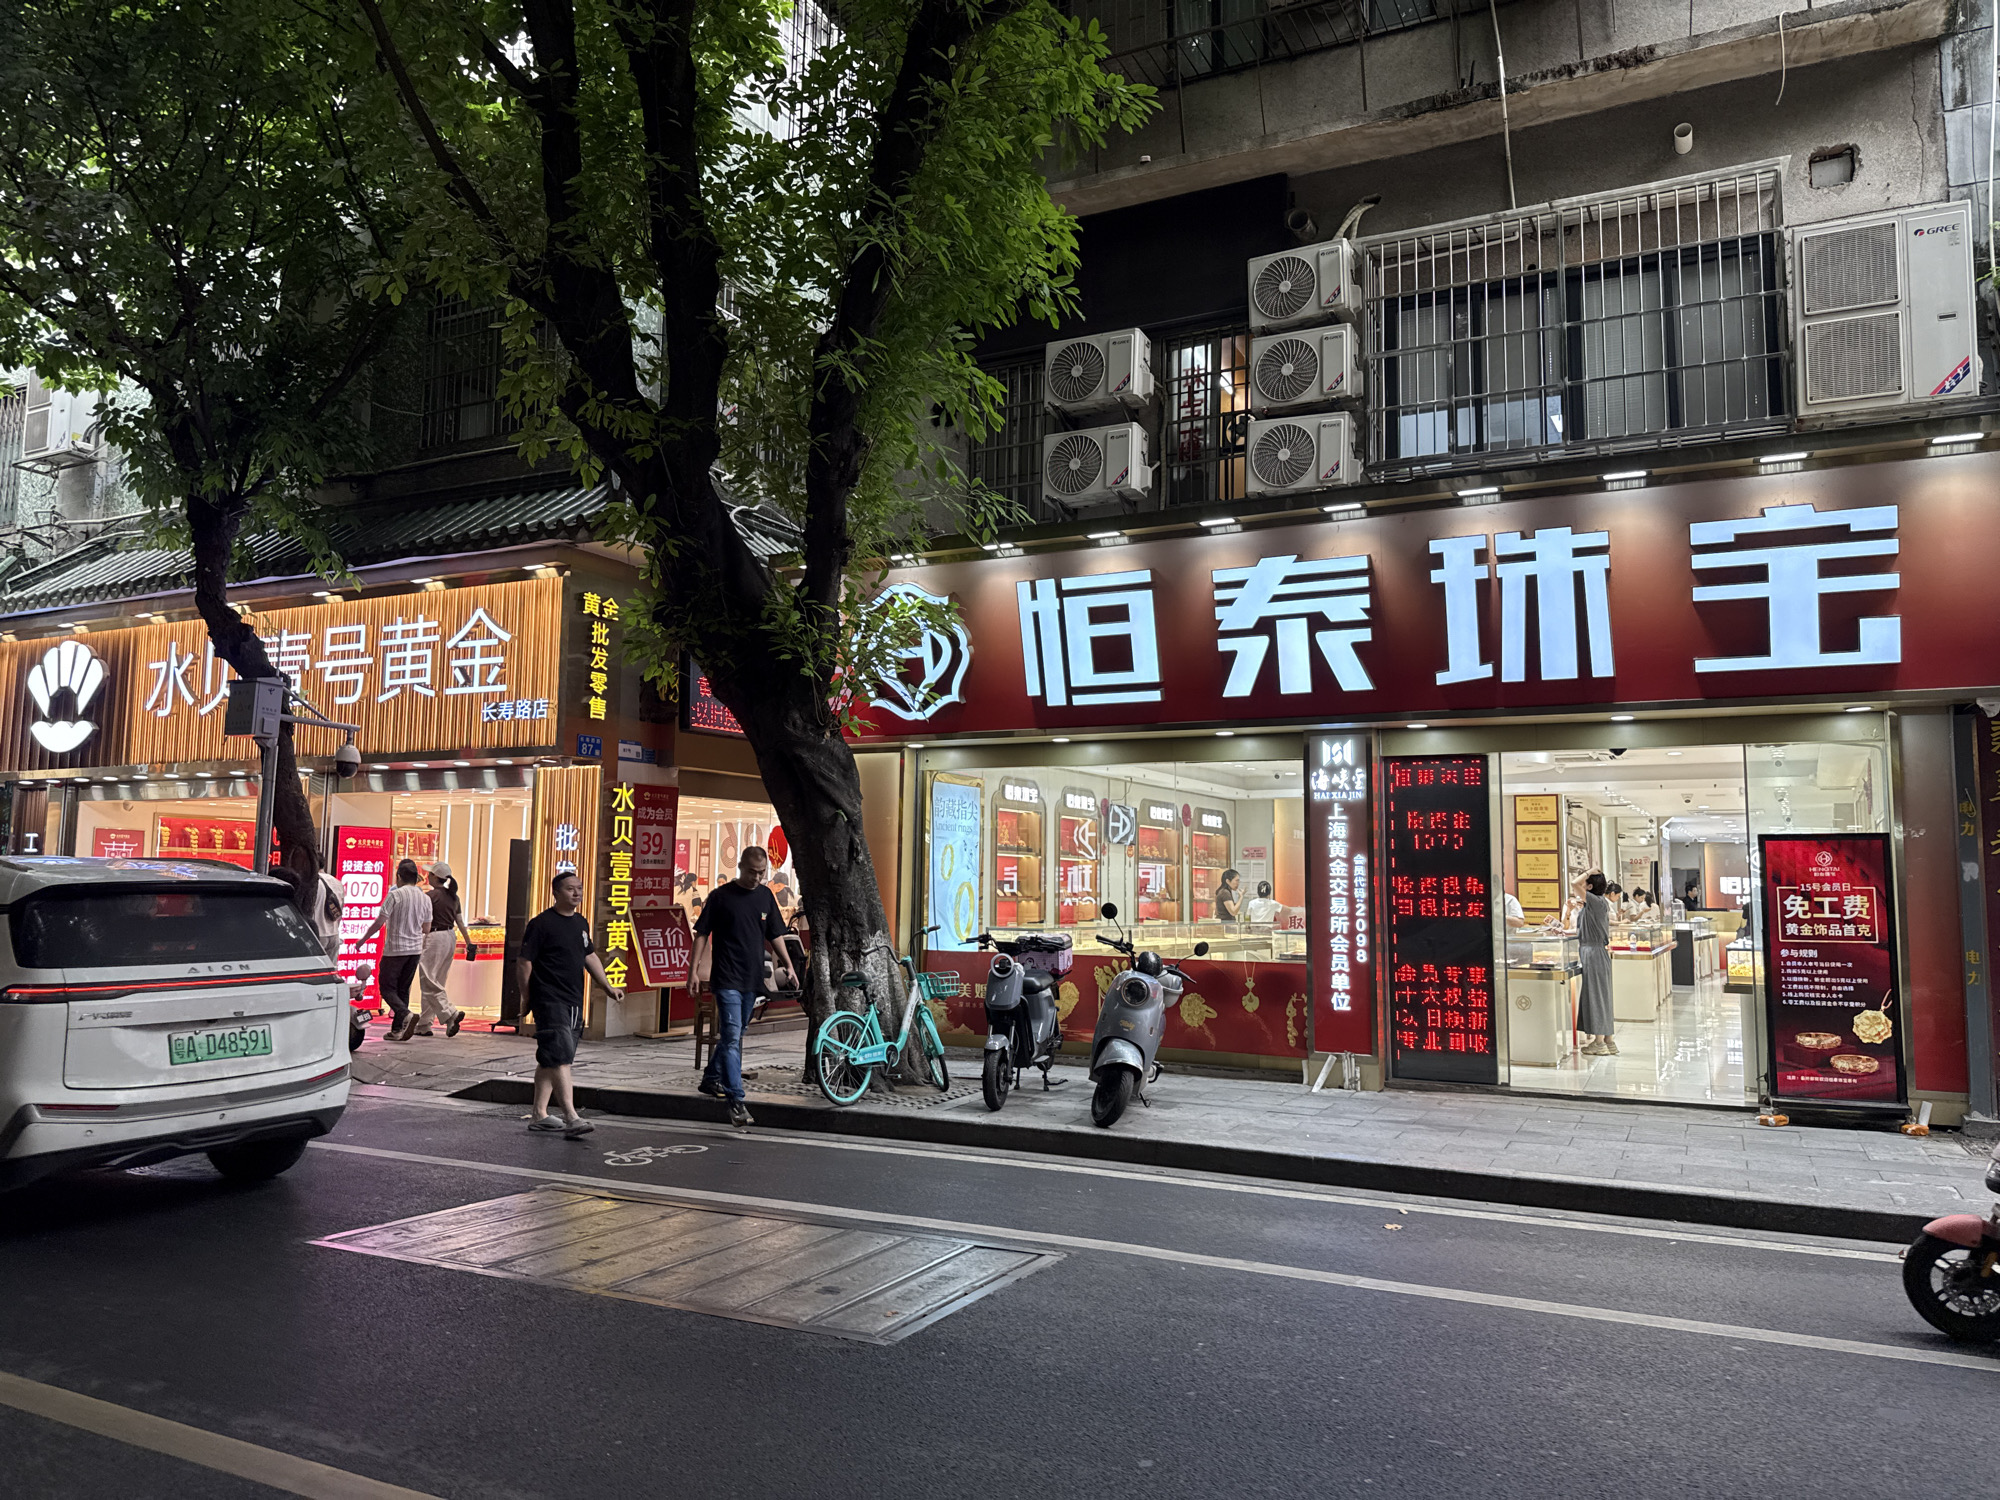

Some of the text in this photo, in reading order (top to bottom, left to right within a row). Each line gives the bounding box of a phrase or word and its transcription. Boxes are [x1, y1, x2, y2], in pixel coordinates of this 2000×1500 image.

[1927, 223, 1960, 235] GREE
[583, 592, 620, 621] 黄金
[1017, 505, 1902, 707] 恒泰珠宝
[588, 621, 610, 721] 批发零售
[481, 697, 549, 723] 长寿路店
[1314, 791, 1362, 800] HAI XIA JIN
[637, 807, 673, 821] 成为会员
[1959, 801, 1976, 836] 电力
[641, 832, 663, 856] 39
[342, 859, 384, 873] 投资金价
[343, 881, 379, 897] 1070
[604, 782, 635, 988] 水贝壹号黄金
[634, 876, 670, 890] 金饰工费
[1800, 883, 1851, 892] 15号会员日
[1328, 803, 1351, 1011] 上海黄金交易所会员单位
[1783, 894, 1871, 919] 免工费
[1288, 915, 1304, 929] 取
[1785, 923, 1872, 937] 黄金饰品首克
[642, 927, 685, 948] 高价
[648, 948, 690, 969] 回收
[1780, 949, 1818, 958] 参与规则
[187, 964, 251, 974] AION
[1966, 949, 1982, 986] 电力
[174, 1029, 269, 1059] 粤A D48591
